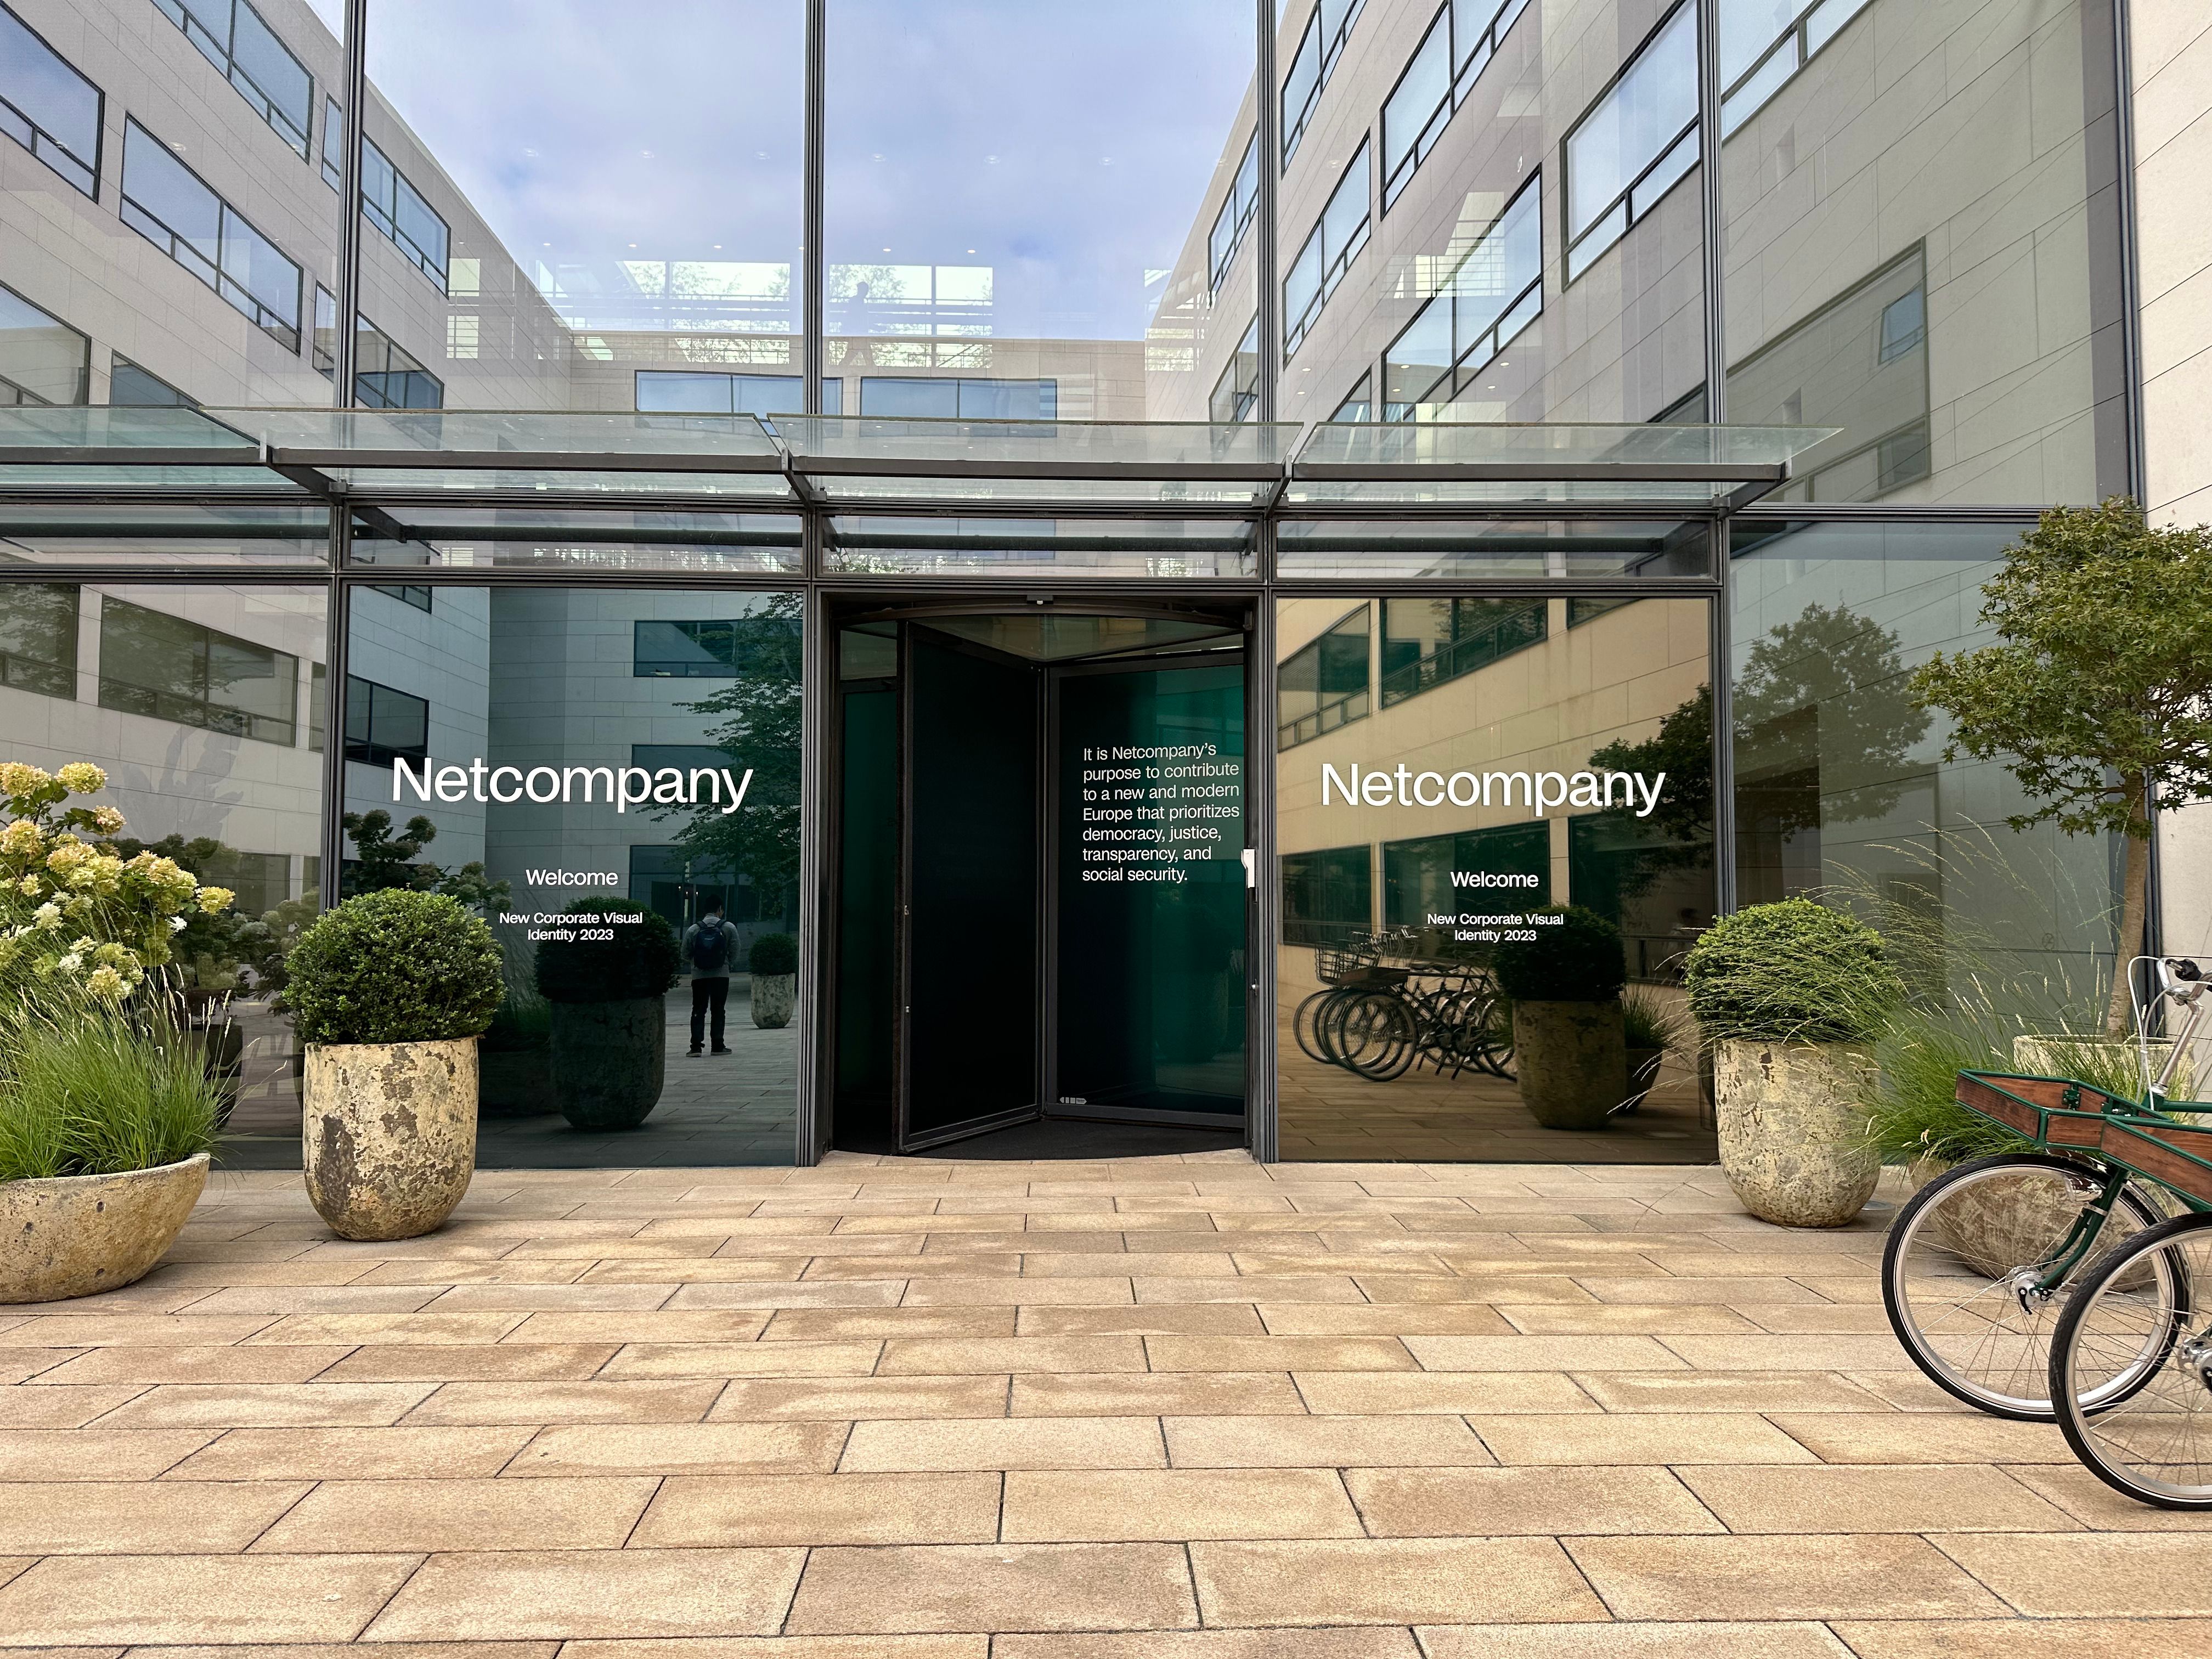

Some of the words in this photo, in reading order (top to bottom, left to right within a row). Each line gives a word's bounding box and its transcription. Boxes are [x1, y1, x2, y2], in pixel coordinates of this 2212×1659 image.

[1084, 748, 1092, 761] It
[1097, 747, 1108, 760] is
[1084, 768, 1141, 783] purpose
[1146, 766, 1160, 778] to
[1164, 763, 1239, 778] contribute
[393, 757, 754, 814] Netcompany
[1083, 788, 1097, 801] to
[1101, 789, 1110, 800] a
[1115, 788, 1145, 800] new
[1149, 785, 1176, 799] and
[1182, 783, 1239, 798] modern
[1322, 763, 1666, 817] Netcompany
[1084, 808, 1133, 823] Europe
[1136, 806, 1165, 820] that
[1169, 804, 1240, 822] prioritizes
[1082, 827, 1165, 843] democracy,
[1169, 826, 1221, 843] justice,
[1082, 848, 1178, 864] transparency,
[1183, 845, 1211, 860] and
[526, 868, 618, 885] Welcome
[1082, 867, 1123, 881] social
[1127, 867, 1188, 884] security.
[1450, 871, 1539, 888] Welcome
[499, 912, 531, 924] New
[533, 912, 600, 926] Corporate
[603, 912, 643, 924] Visual
[1427, 913, 1457, 924] New
[1459, 913, 1522, 927] Corporate
[1526, 913, 1564, 925] Visual
[528, 928, 577, 943] Identity
[580, 929, 614, 940] 2023
[1455, 929, 1501, 943] Identity
[1504, 929, 1537, 941] 2023
